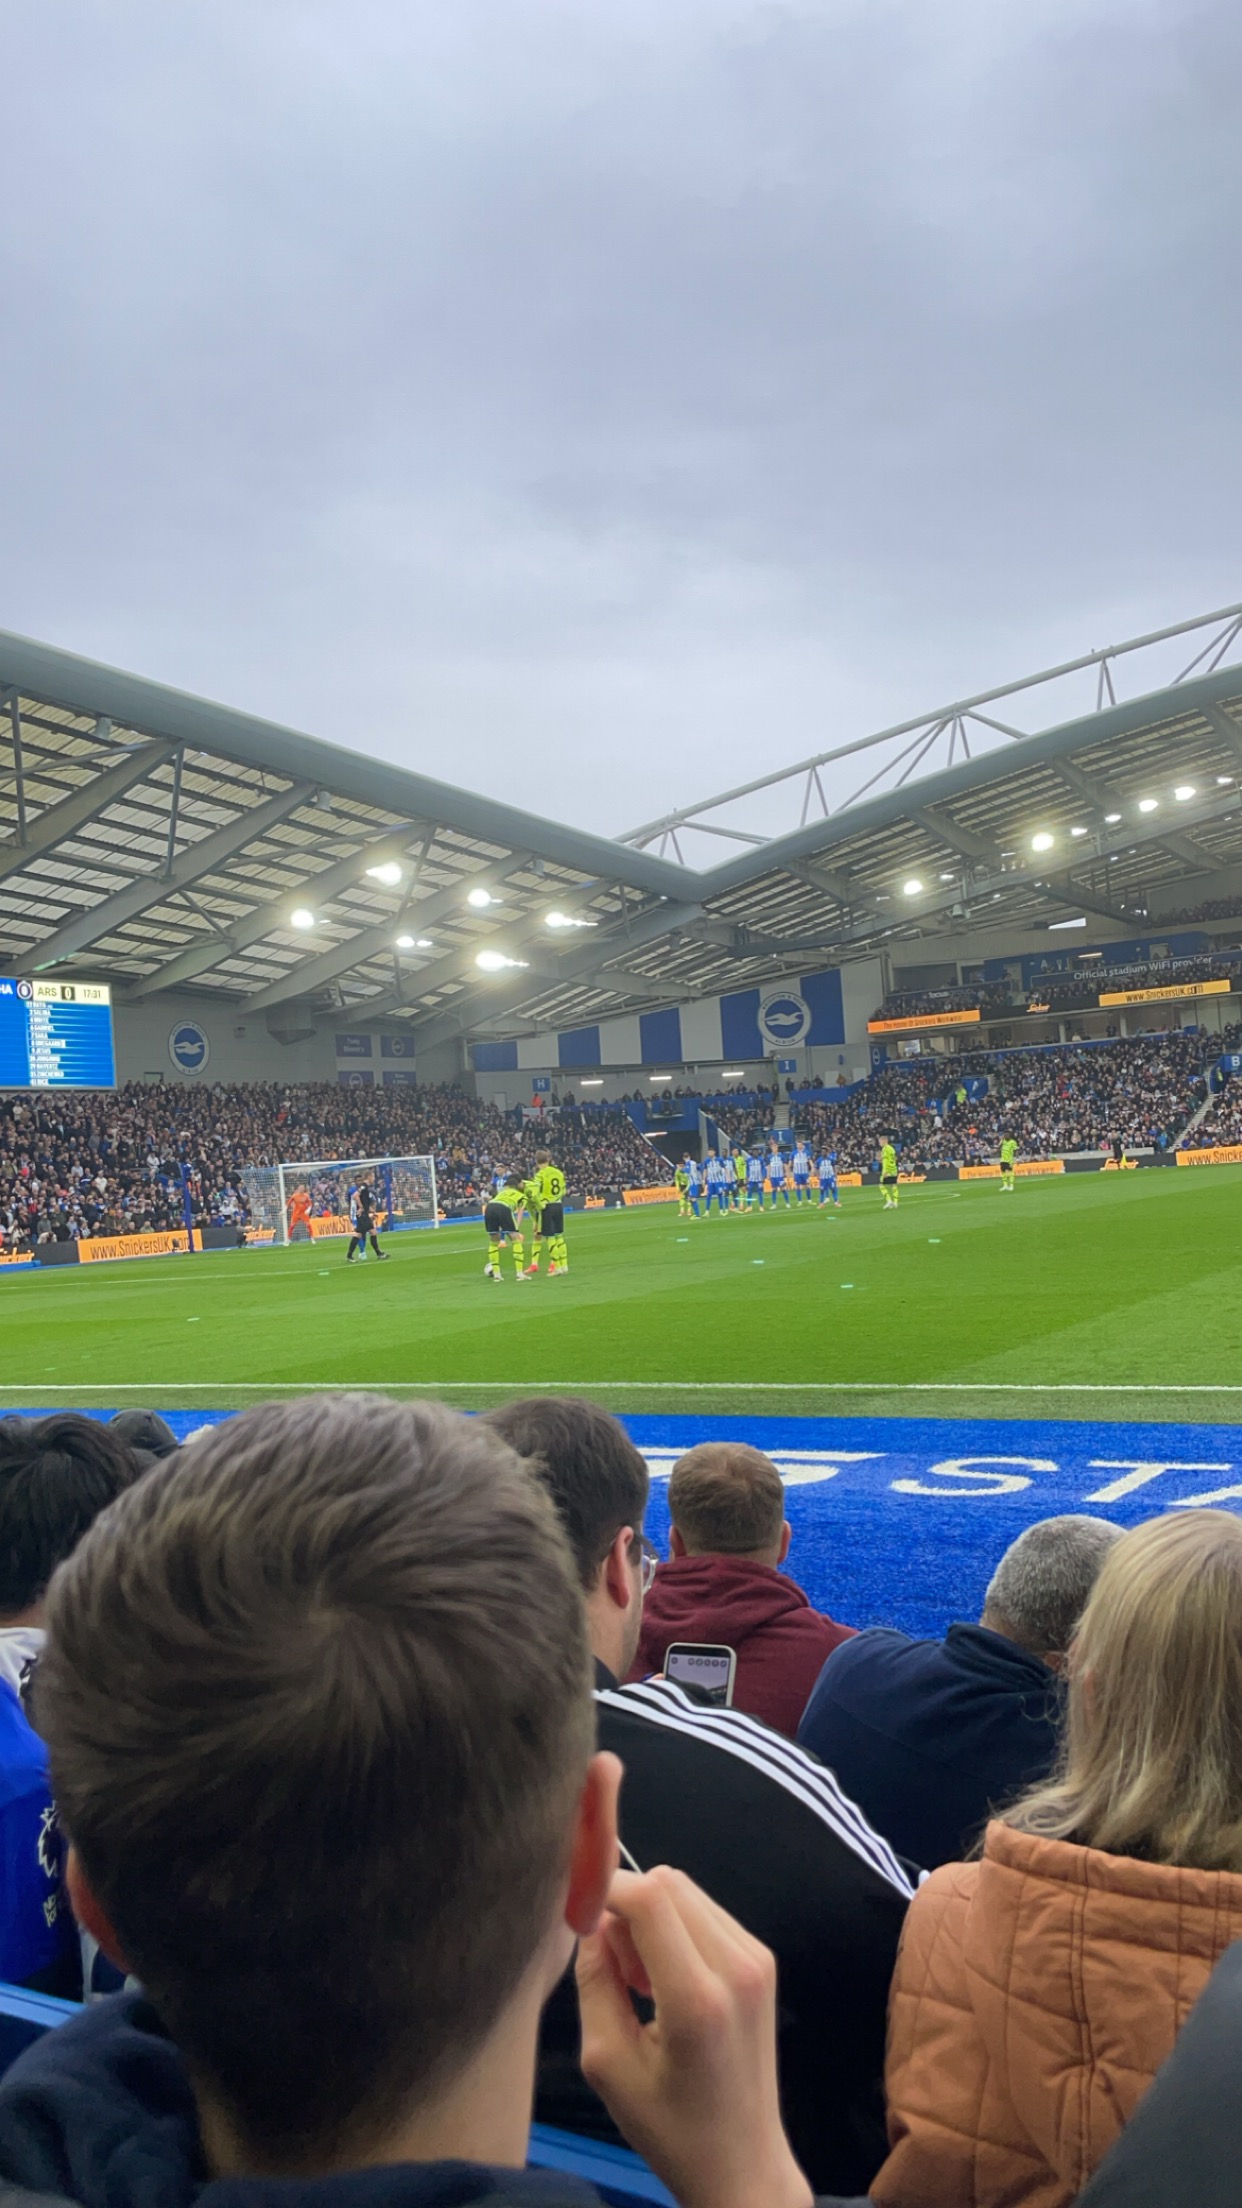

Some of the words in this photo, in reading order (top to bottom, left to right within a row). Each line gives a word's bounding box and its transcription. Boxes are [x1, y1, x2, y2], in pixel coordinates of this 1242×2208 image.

[1073, 969, 1107, 980] Official
[1108, 964, 1147, 977] stadium
[1148, 960, 1171, 971] WiFi
[37, 986, 57, 997] ARS
[64, 987, 72, 999] 0
[1231, 1055, 1241, 1067] B
[537, 1079, 545, 1088] H
[550, 1178, 560, 1196] 8
